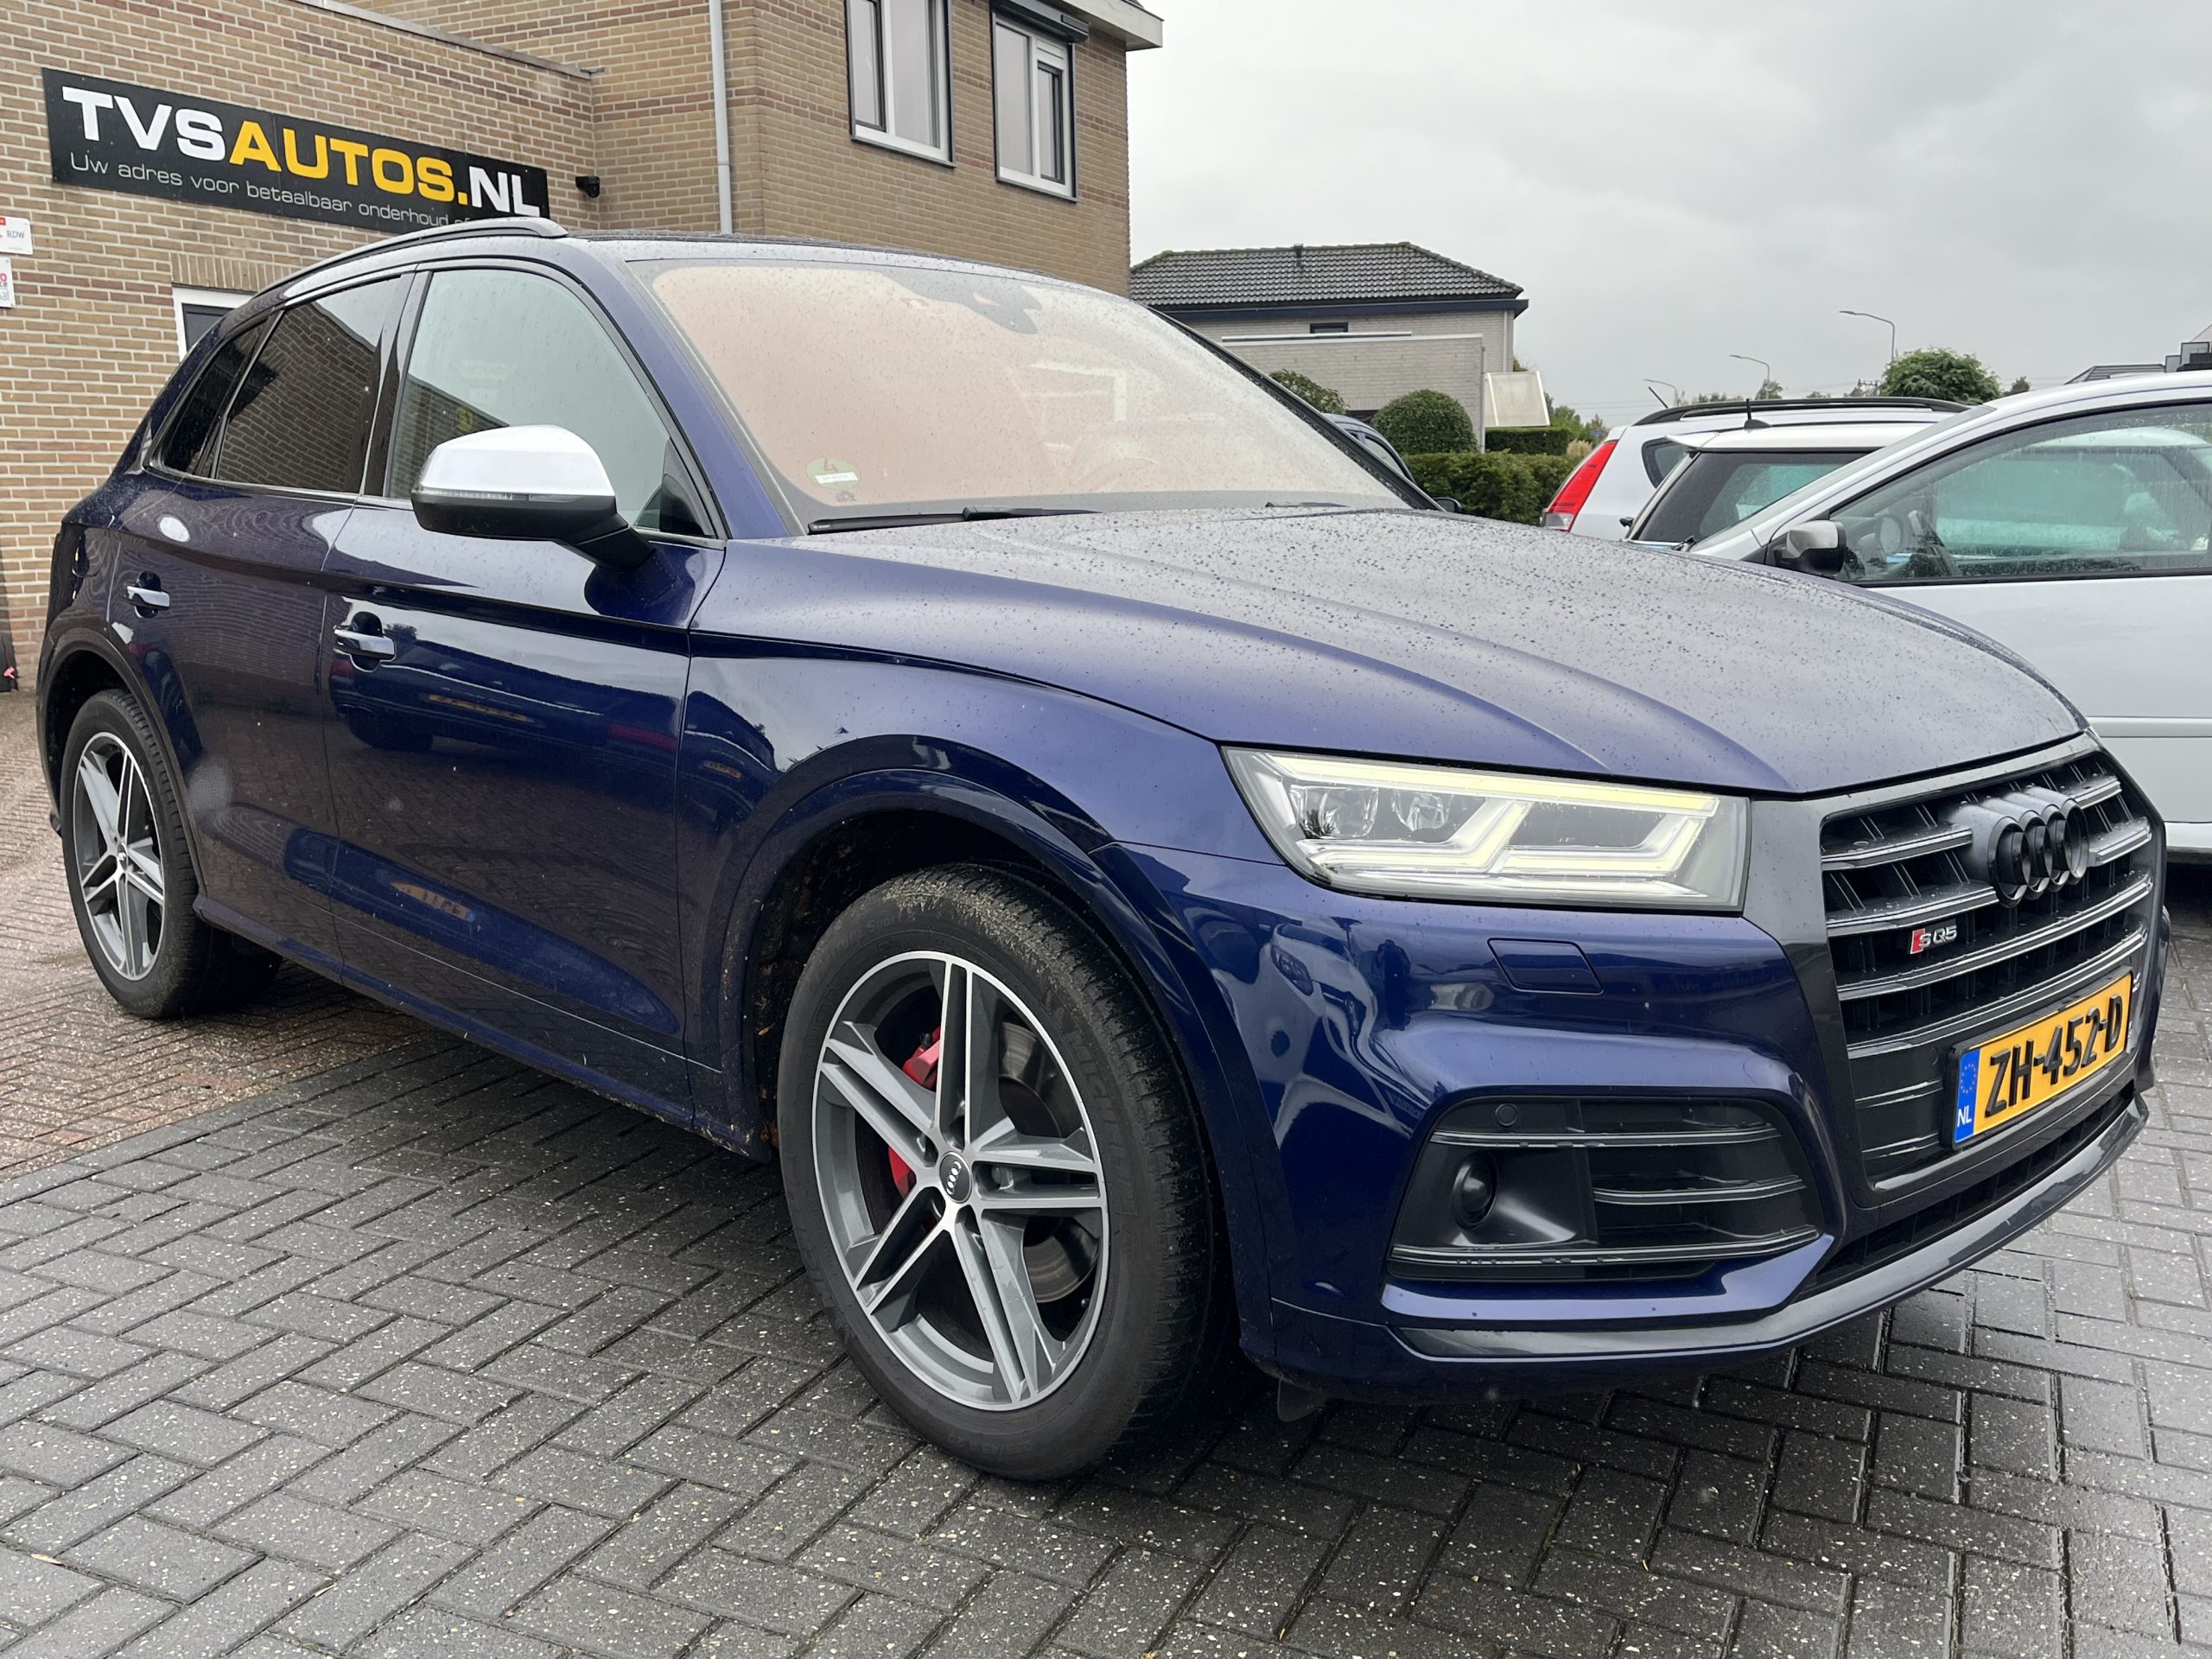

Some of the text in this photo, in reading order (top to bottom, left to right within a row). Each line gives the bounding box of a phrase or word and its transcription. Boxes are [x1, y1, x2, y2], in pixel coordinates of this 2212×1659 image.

[62, 86, 540, 217] TVSAUTOS.NL
[71, 151, 449, 226] Uw adres voor betaalbaar onderhoud
[7, 230, 25, 239] RDW
[1918, 925, 1957, 948] SQ5
[1985, 995, 2123, 1118] ZH-452-D
[1957, 1106, 1972, 1128] NL
